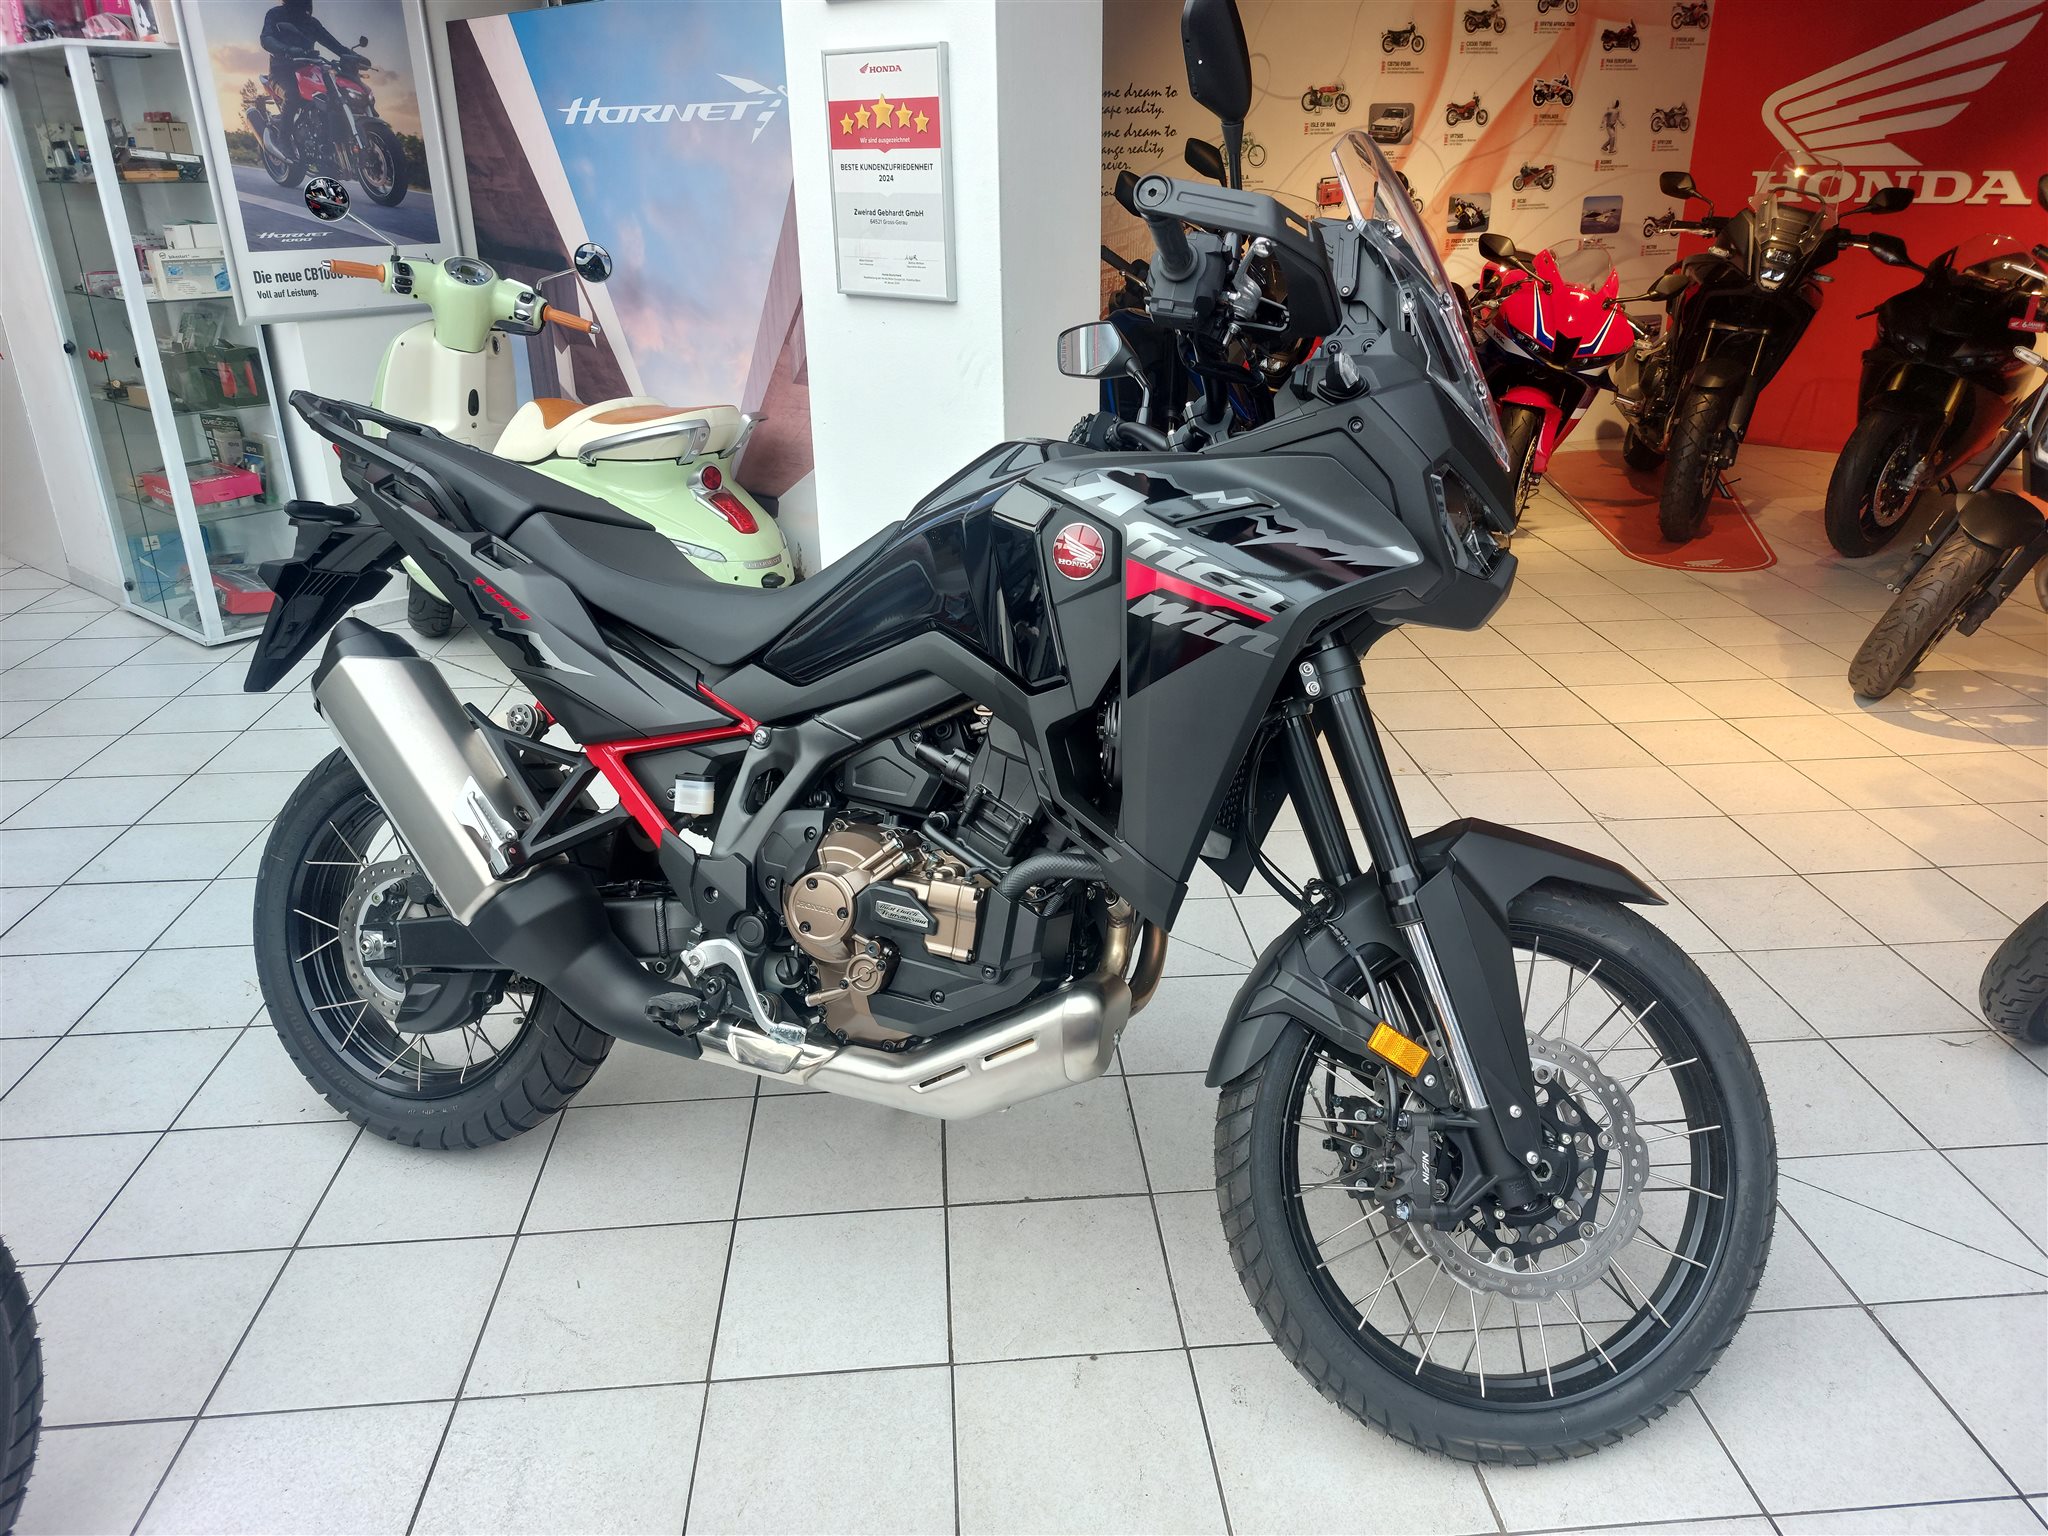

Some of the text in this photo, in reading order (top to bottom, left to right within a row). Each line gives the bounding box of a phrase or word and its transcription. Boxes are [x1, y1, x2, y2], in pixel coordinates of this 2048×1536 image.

[869, 65, 902, 74] HONDA
[1102, 82, 1178, 98] me dream to
[558, 96, 766, 125] HORNET
[1125, 100, 1165, 119] reality.
[1102, 122, 1177, 138] me dream to
[878, 137, 911, 145] ausgezeichnet
[1127, 140, 1165, 159] reality
[841, 163, 934, 171] BESTE KUNDENZUFRIEDENHEIT
[1102, 162, 1132, 171] rever.
[1748, 170, 2032, 205] HONDA
[877, 209, 904, 217] Gebhardt
[256, 231, 334, 239] HORNET
[253, 270, 273, 284] Die
[275, 271, 303, 283] neue
[257, 288, 319, 299] Voll auf Leistung.
[1058, 558, 1094, 570] HONDA
[472, 576, 532, 621] 1100
[796, 900, 835, 917] HONDA
[1422, 1150, 1431, 1186] NISSIN
